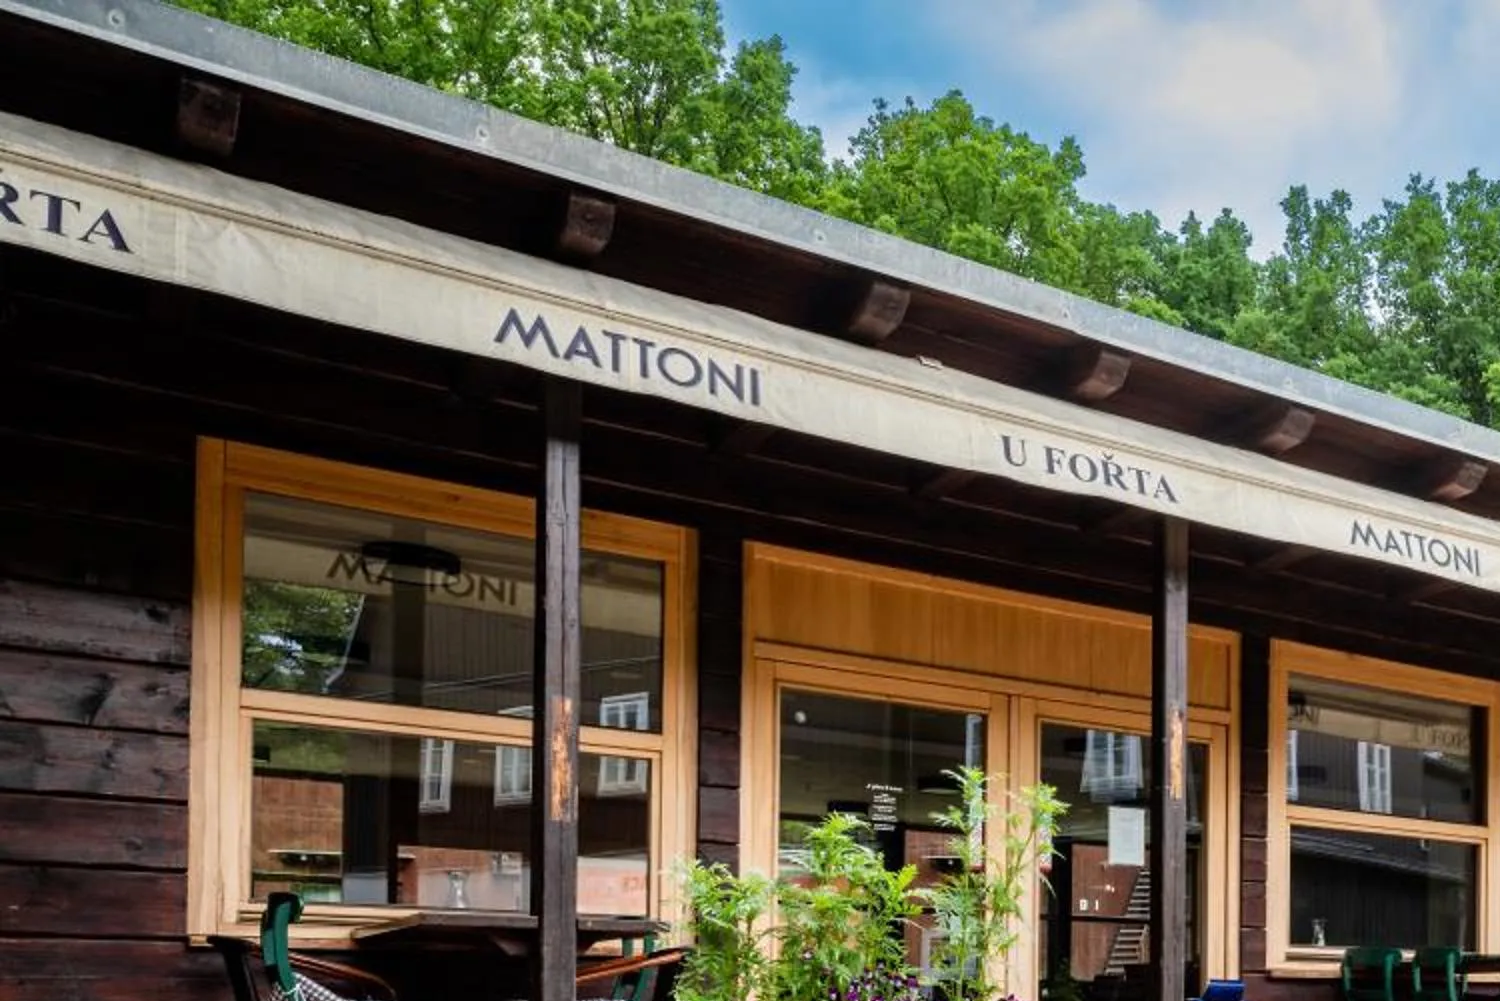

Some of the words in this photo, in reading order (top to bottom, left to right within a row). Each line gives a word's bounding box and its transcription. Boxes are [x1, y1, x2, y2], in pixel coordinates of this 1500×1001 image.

[494, 308, 760, 406] MATTONI
[1002, 435, 1027, 467] U
[1044, 446, 1179, 503] FOŘTA
[1351, 520, 1480, 576] MATTONI
